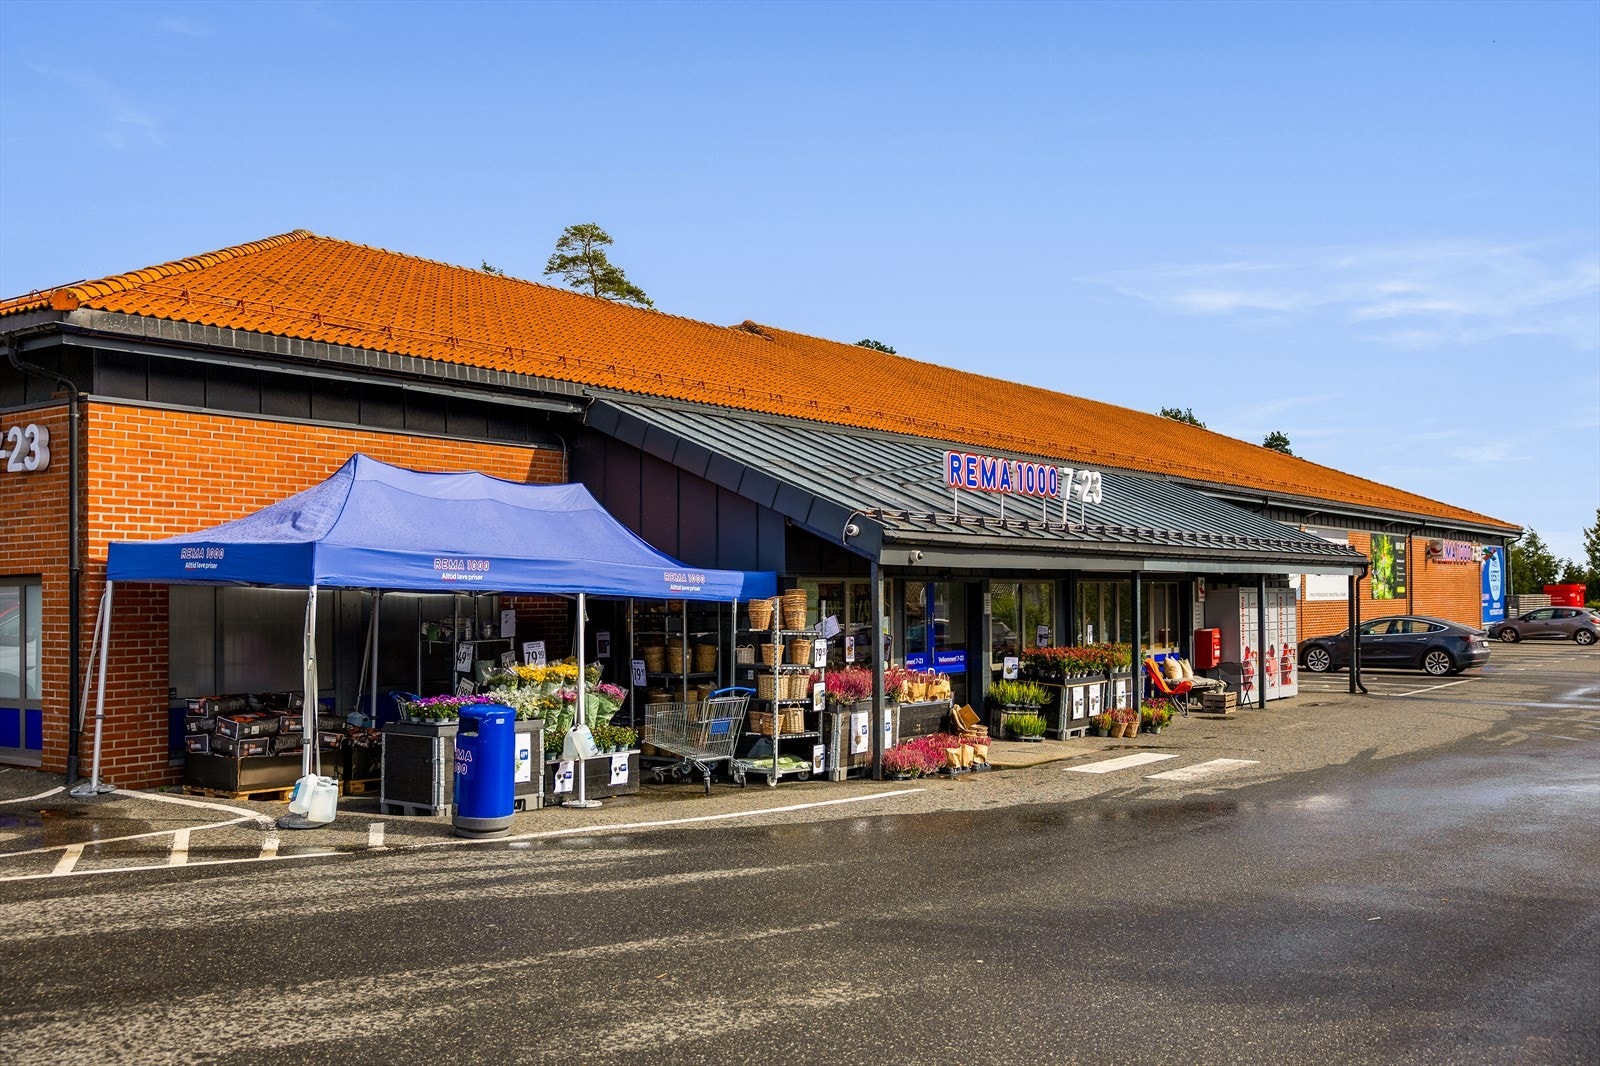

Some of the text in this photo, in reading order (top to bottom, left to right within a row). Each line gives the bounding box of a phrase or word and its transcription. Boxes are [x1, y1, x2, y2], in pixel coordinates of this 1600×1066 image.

[0, 424, 46, 472] -23
[945, 451, 1102, 504] REMA 1000 7-23
[180, 547, 225, 559] REMA 1000
[433, 558, 490, 571] REMA 1000
[664, 572, 705, 584] REMA 1000
[455, 748, 473, 762] MA
[455, 762, 468, 775] 00
